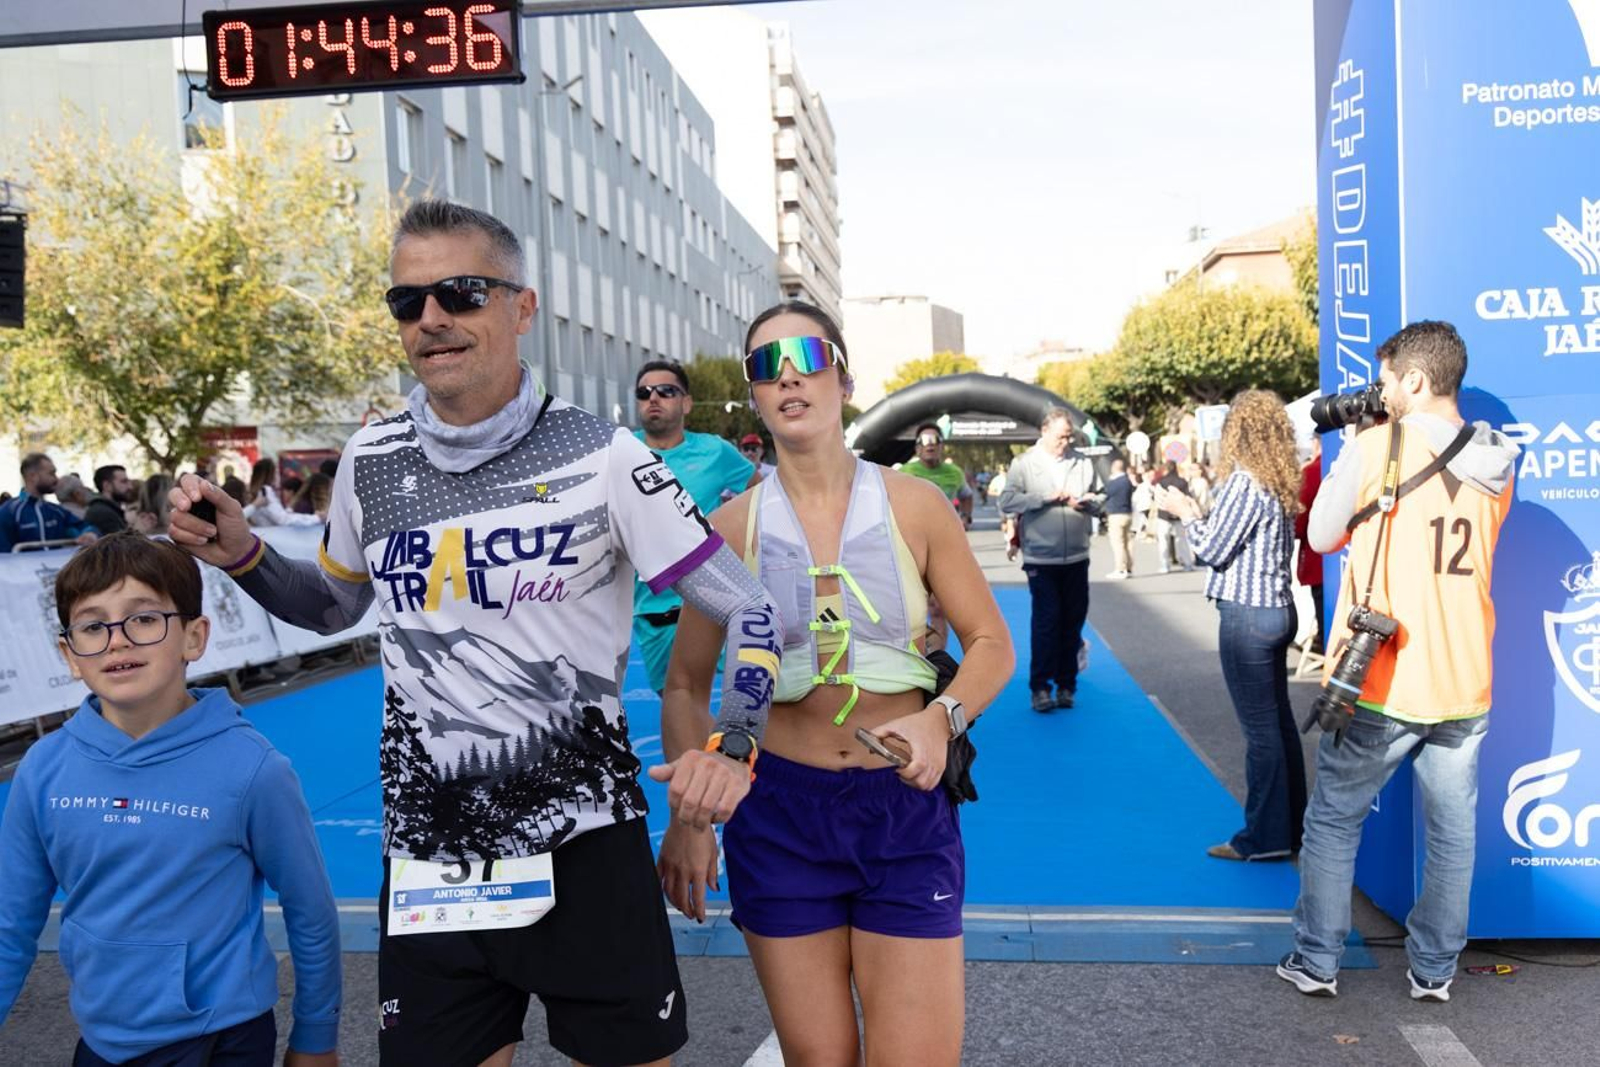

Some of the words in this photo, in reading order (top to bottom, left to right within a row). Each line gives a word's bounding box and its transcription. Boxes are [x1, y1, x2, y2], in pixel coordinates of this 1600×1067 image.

[217, 4, 502, 87] 01:44:36
[1462, 78, 1576, 104] Patronato
[1494, 103, 1600, 131] Deportes
[1475, 287, 1570, 320] CAJA
[371, 523, 578, 579] JABALCUZ
[1430, 516, 1474, 577] 12
[502, 569, 570, 620] Jaén
[50, 797, 109, 809] TOMMY
[133, 799, 210, 820] HILFIGER
[103, 814, 121, 823] EST.
[123, 815, 141, 824] 1985
[433, 888, 478, 899] ANTONIO
[480, 886, 513, 897] JAVIER
